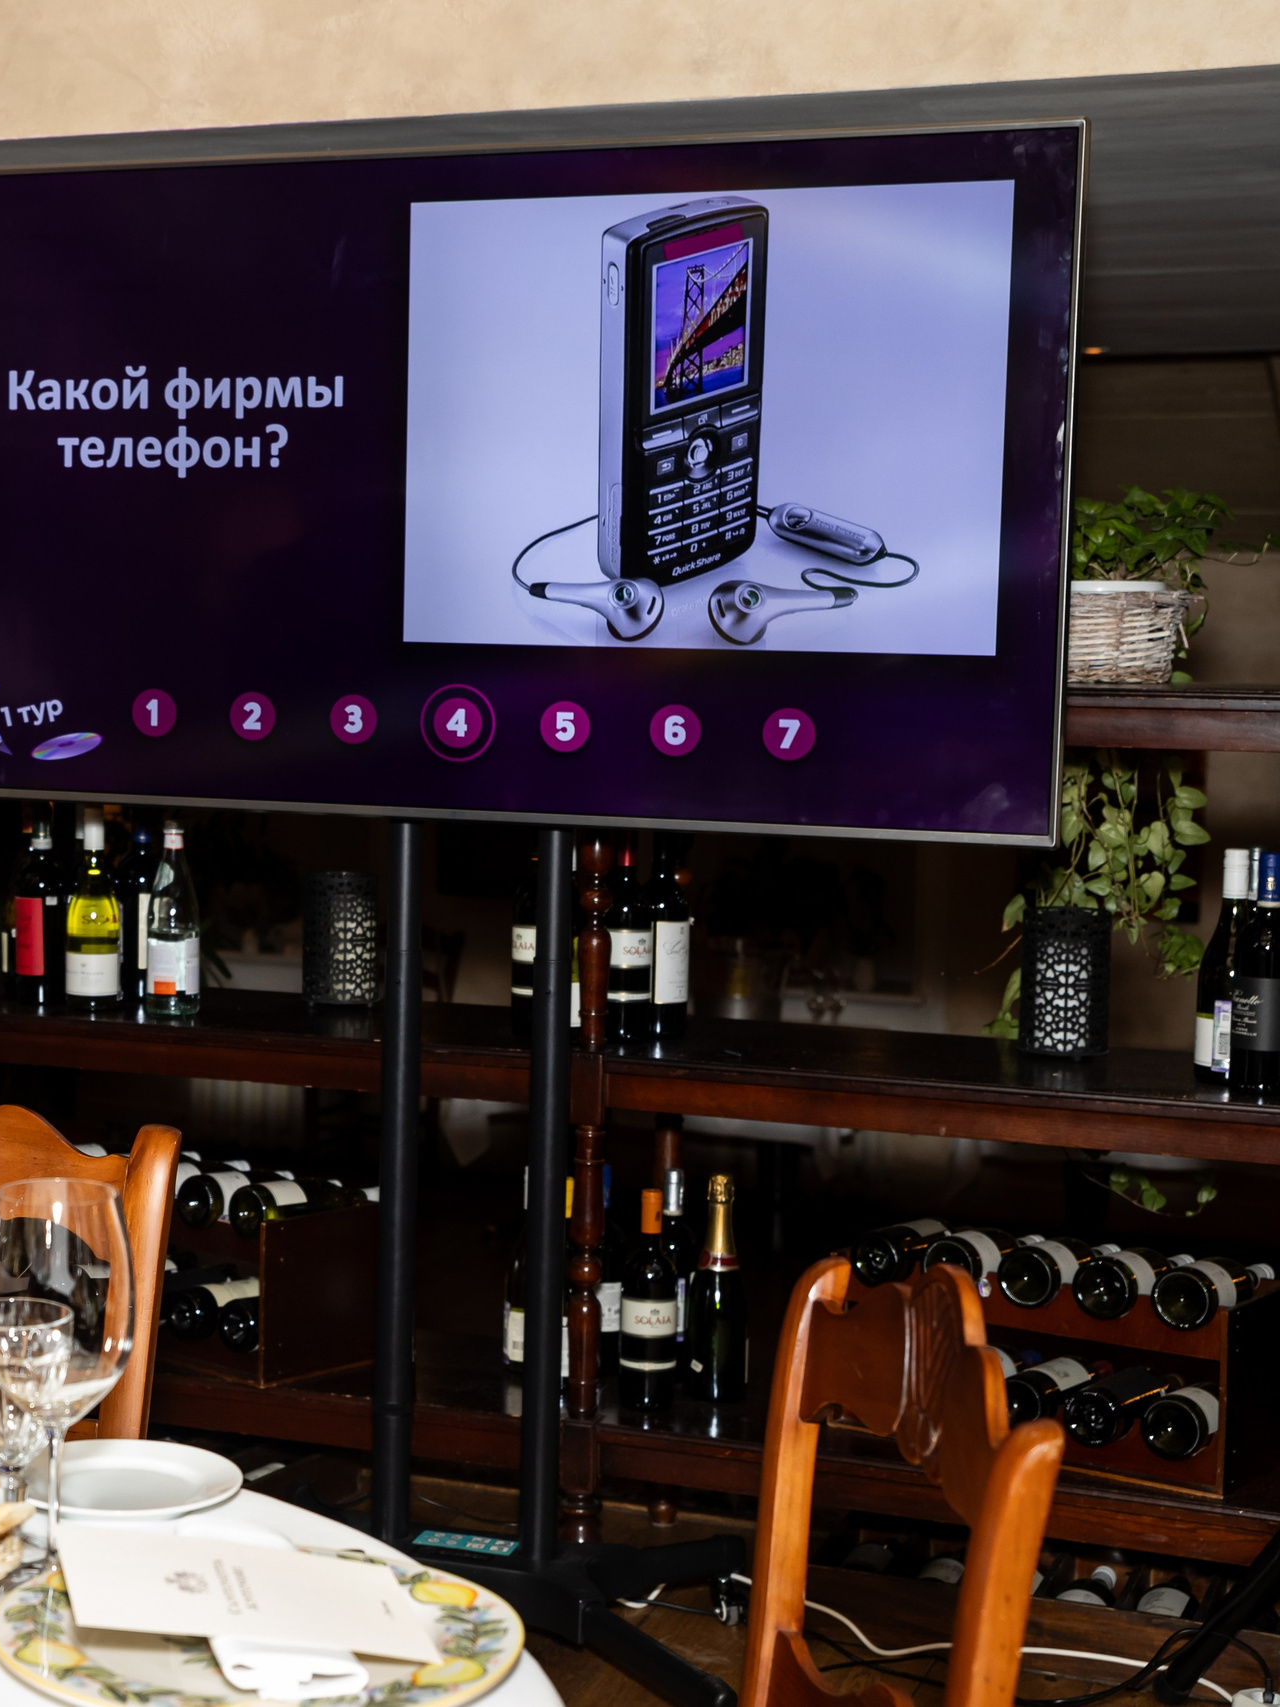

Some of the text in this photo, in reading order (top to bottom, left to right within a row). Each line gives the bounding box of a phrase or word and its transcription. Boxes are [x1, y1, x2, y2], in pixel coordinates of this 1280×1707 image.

[8, 365, 345, 420] Какой фирмы
[56, 423, 290, 478] телефон?
[0, 698, 64, 727] 1 тур
[145, 698, 159, 727] 1
[242, 701, 262, 731] 2
[343, 704, 364, 734] 3
[445, 708, 468, 737] 4
[554, 711, 576, 742] 5
[663, 715, 687, 746] 6
[778, 718, 801, 750] 7
[634, 1315, 672, 1325] SOLAIA
